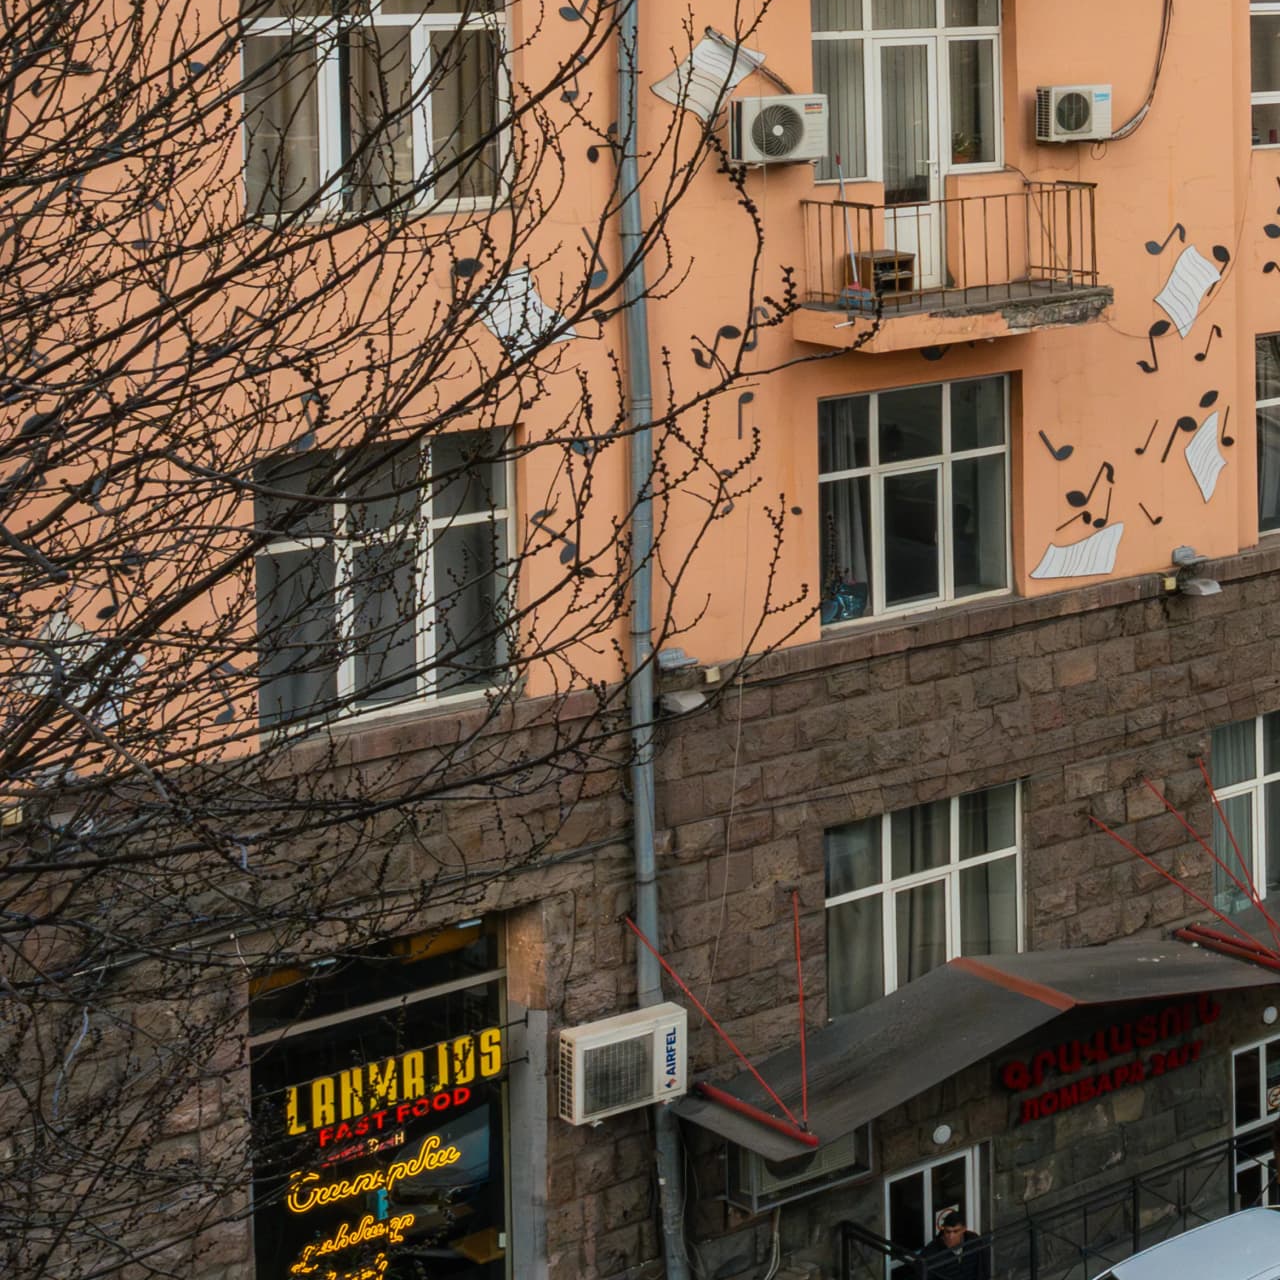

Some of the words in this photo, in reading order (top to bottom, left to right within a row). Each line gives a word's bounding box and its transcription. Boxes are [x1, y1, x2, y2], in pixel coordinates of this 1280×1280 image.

[286, 1027, 502, 1136] LAHMAJOS
[666, 1026, 677, 1075] AIRFEL
[318, 1109, 387, 1148] FAST
[396, 1087, 472, 1124] FOOD
[1020, 1059, 1145, 1125] ЛОМБАРД
